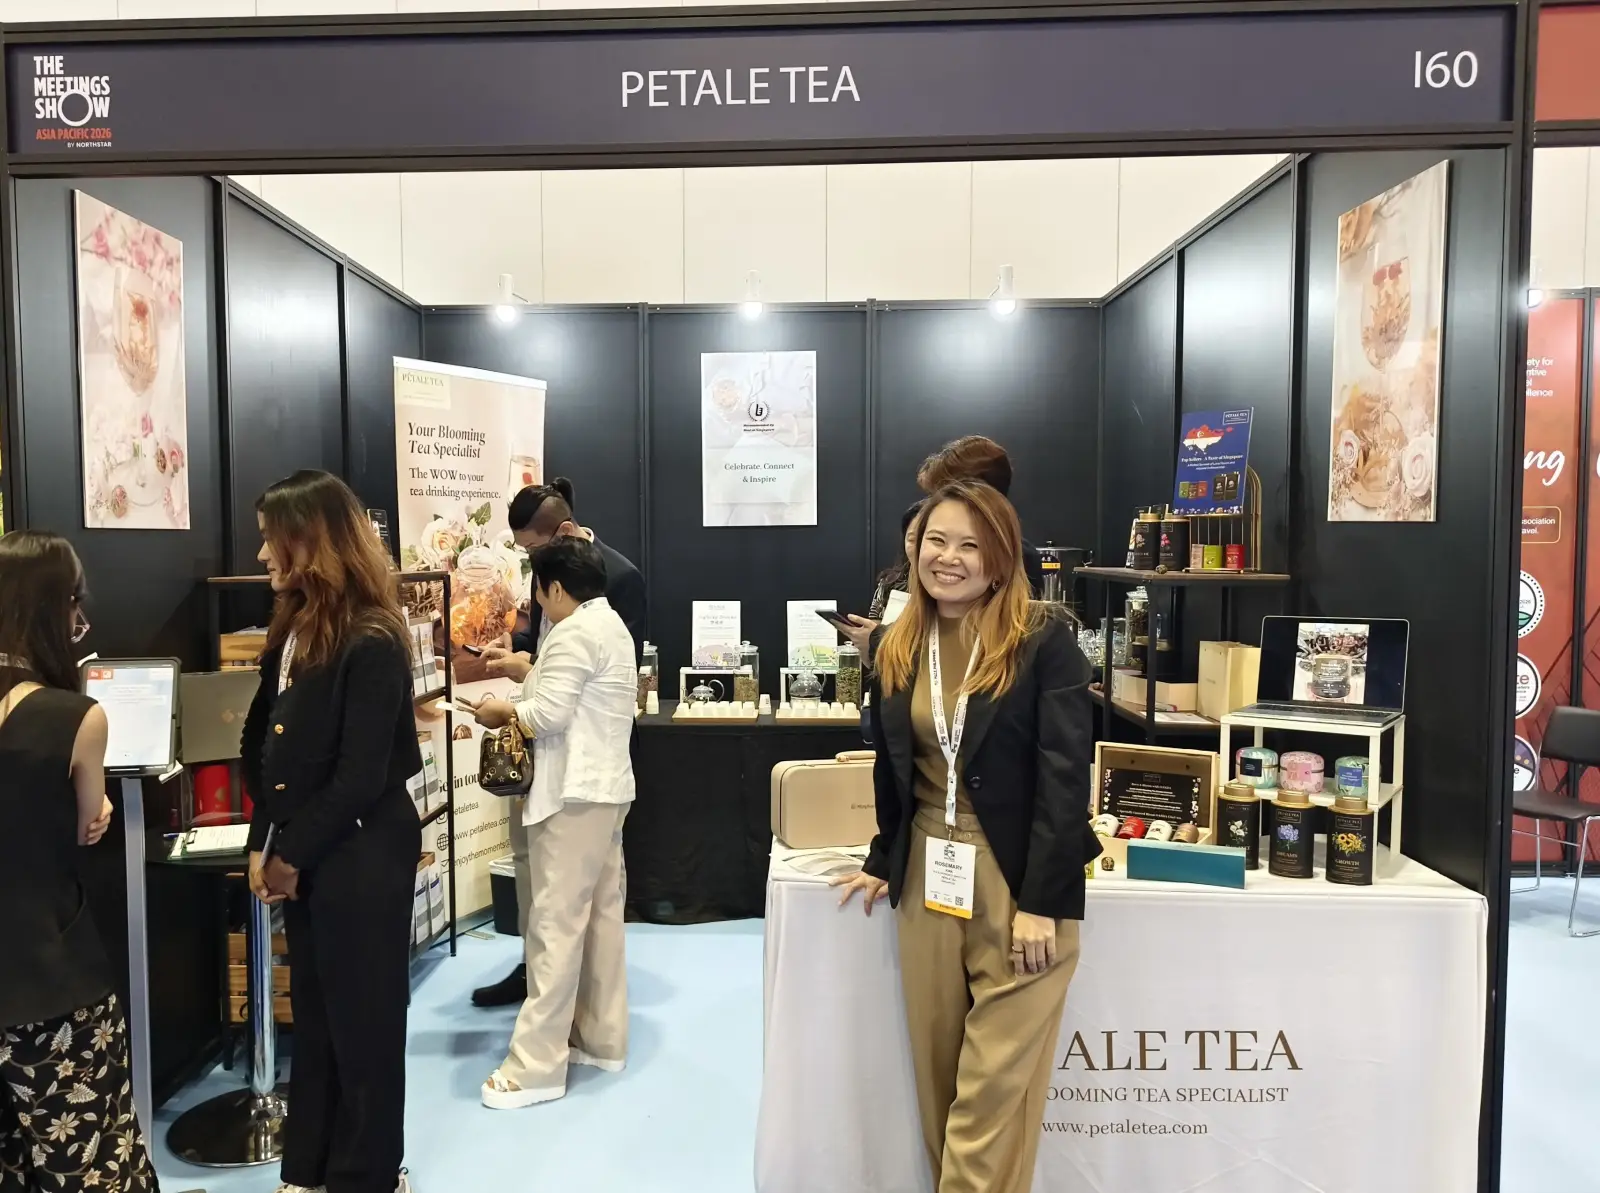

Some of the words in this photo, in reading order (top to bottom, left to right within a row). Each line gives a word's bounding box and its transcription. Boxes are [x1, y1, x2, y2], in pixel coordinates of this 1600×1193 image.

[33, 55, 64, 75] THE
[34, 75, 110, 96] MEETINGS
[621, 68, 771, 108] PETALE
[779, 65, 861, 104] TEA
[35, 97, 110, 127] SHOW
[36, 129, 56, 140] ASIA
[57, 128, 89, 140] PACIFIC
[91, 128, 112, 139] 2026
[408, 422, 436, 438] Your
[438, 424, 486, 446] Blooming
[408, 440, 430, 455] Tea
[433, 442, 481, 460] Specialist
[763, 462, 795, 470] Connect
[409, 467, 428, 479] The
[429, 468, 458, 481] WOW
[459, 472, 466, 481] to
[467, 474, 485, 485] your
[742, 475, 748, 483] &
[750, 475, 777, 484] Inspire
[409, 487, 424, 497] tea
[425, 485, 461, 501] drinking
[461, 489, 501, 502] experience.
[454, 775, 463, 789] in
[1184, 1029, 1303, 1071] TEA
[1133, 1087, 1171, 1103] TEA
[1176, 1086, 1289, 1103] SPECIALIST
[1041, 1119, 1209, 1138] www.petaletea.com
